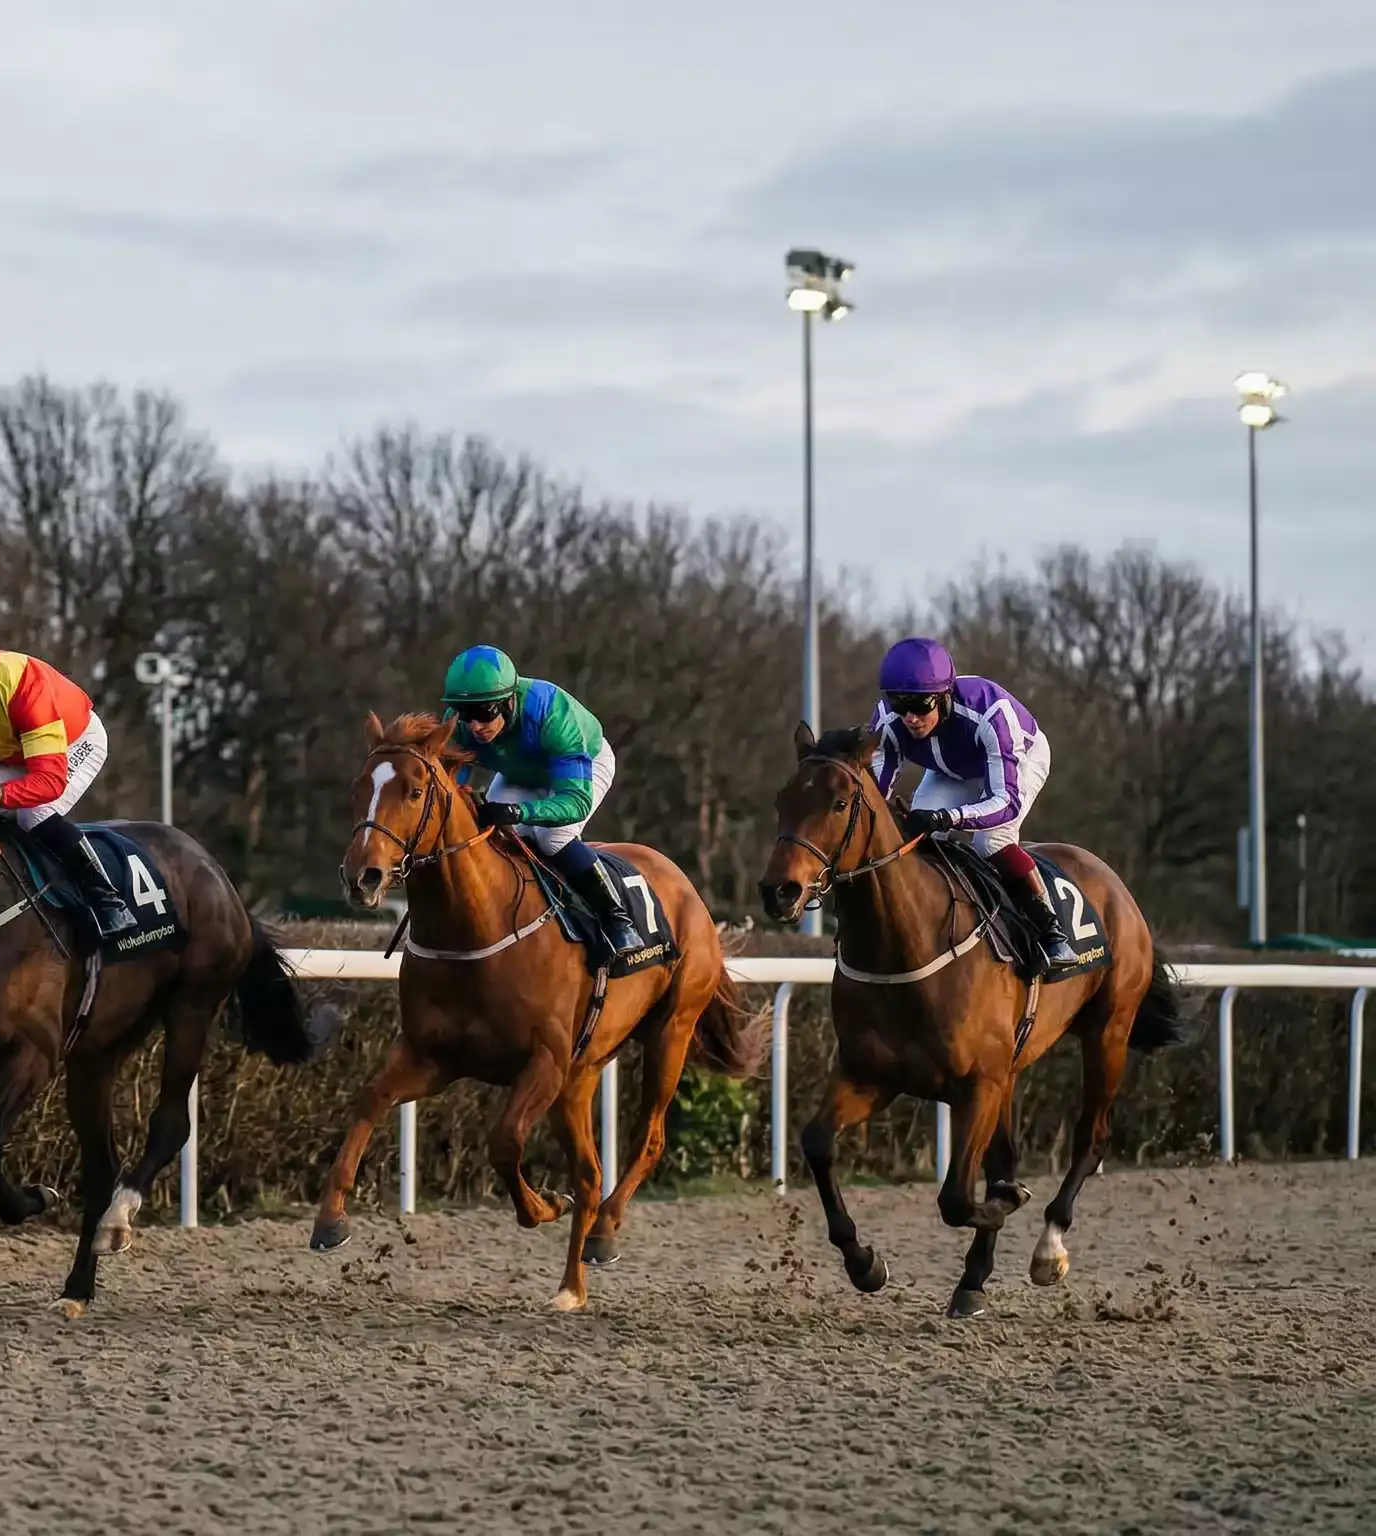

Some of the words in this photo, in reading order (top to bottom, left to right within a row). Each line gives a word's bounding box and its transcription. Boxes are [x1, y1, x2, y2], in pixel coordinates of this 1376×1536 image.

[127, 854, 167, 915] 4
[622, 874, 659, 934] 7
[1054, 877, 1098, 941] 2
